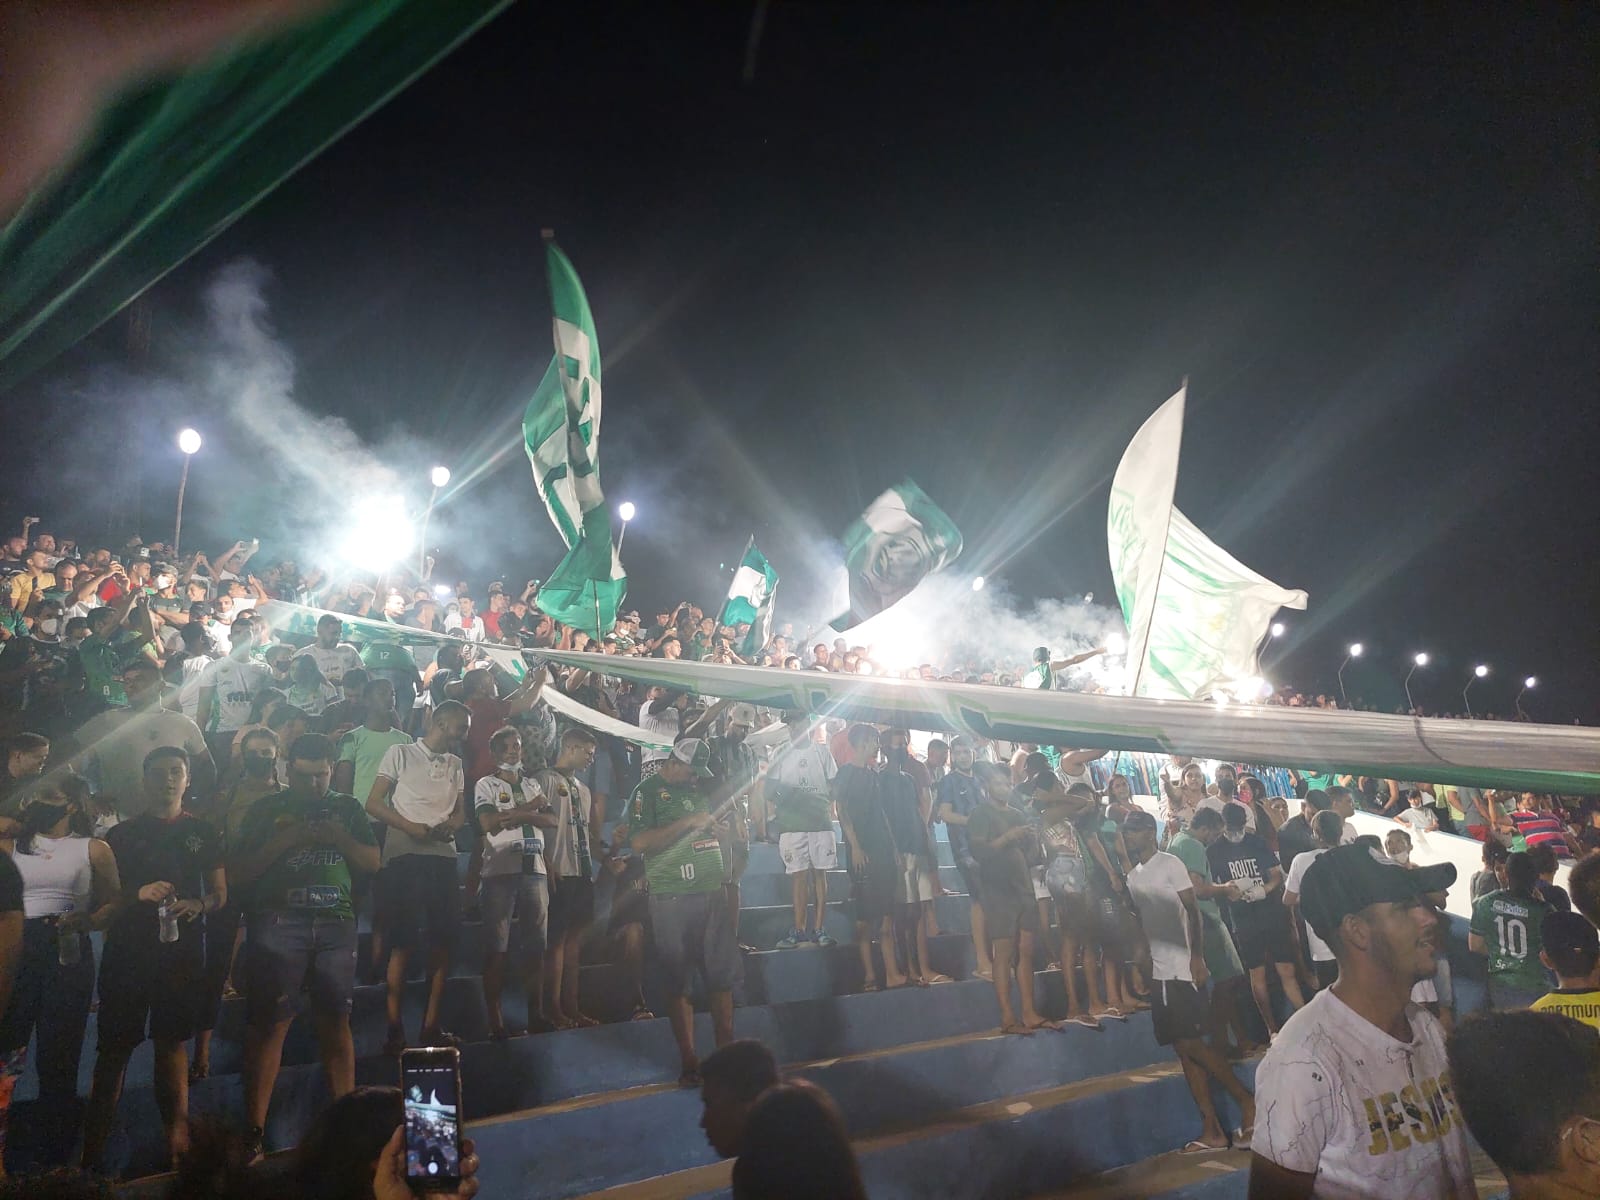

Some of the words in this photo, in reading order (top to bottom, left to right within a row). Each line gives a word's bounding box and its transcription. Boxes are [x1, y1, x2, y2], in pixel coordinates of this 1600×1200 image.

[680, 863, 695, 880] 10
[1228, 858, 1260, 879] ROUTE
[1494, 915, 1527, 959] 10
